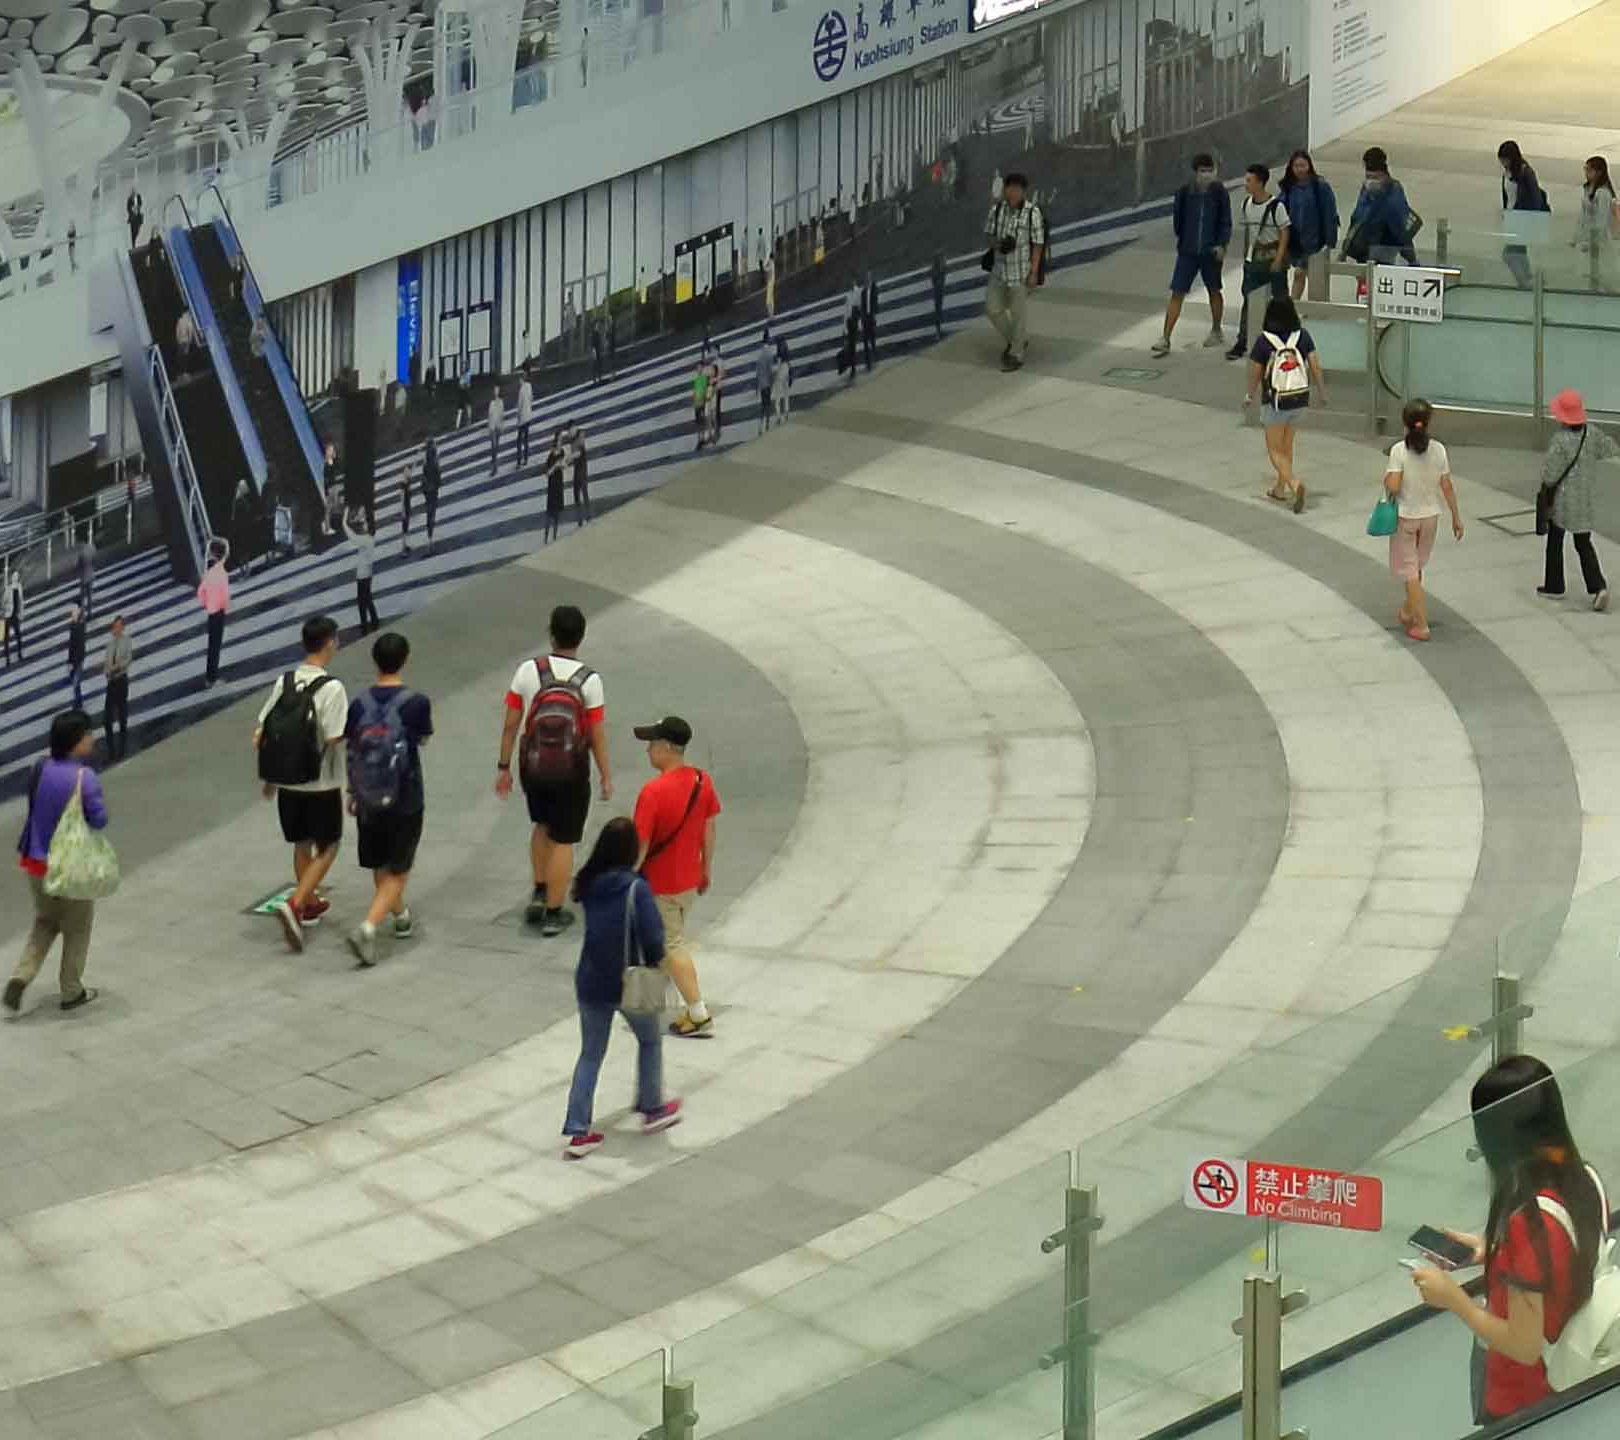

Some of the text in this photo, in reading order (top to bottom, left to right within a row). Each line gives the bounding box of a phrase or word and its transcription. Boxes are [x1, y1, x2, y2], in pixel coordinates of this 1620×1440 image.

[854, 18, 958, 71] Kaohsiung Station
[1378, 277, 1418, 296] 出口
[1255, 1168, 1357, 1208] 禁止攀爬
[1253, 1198, 1341, 1226] No Climbing
